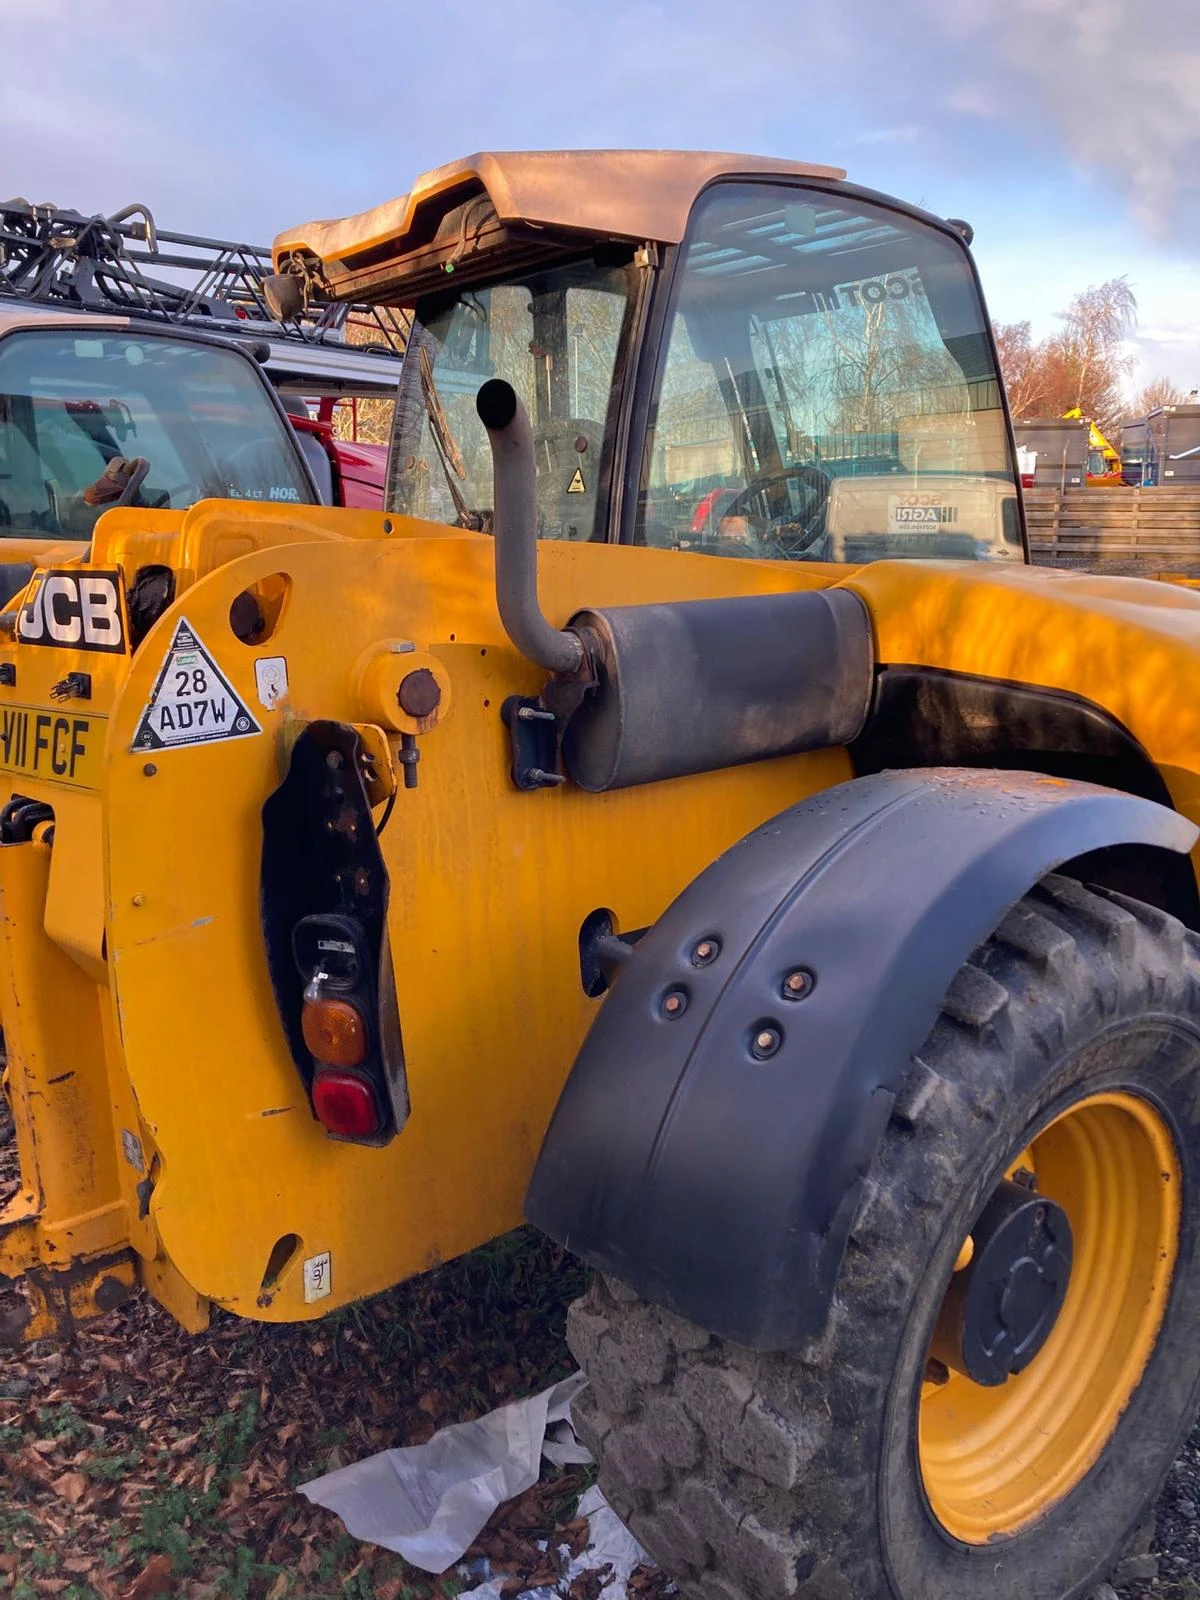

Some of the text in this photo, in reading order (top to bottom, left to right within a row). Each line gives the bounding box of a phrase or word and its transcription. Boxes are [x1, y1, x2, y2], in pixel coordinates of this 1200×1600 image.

[19, 576, 122, 646] JCB
[175, 668, 208, 697] 28
[160, 697, 226, 732] AD7W
[33, 714, 90, 778] FCF
